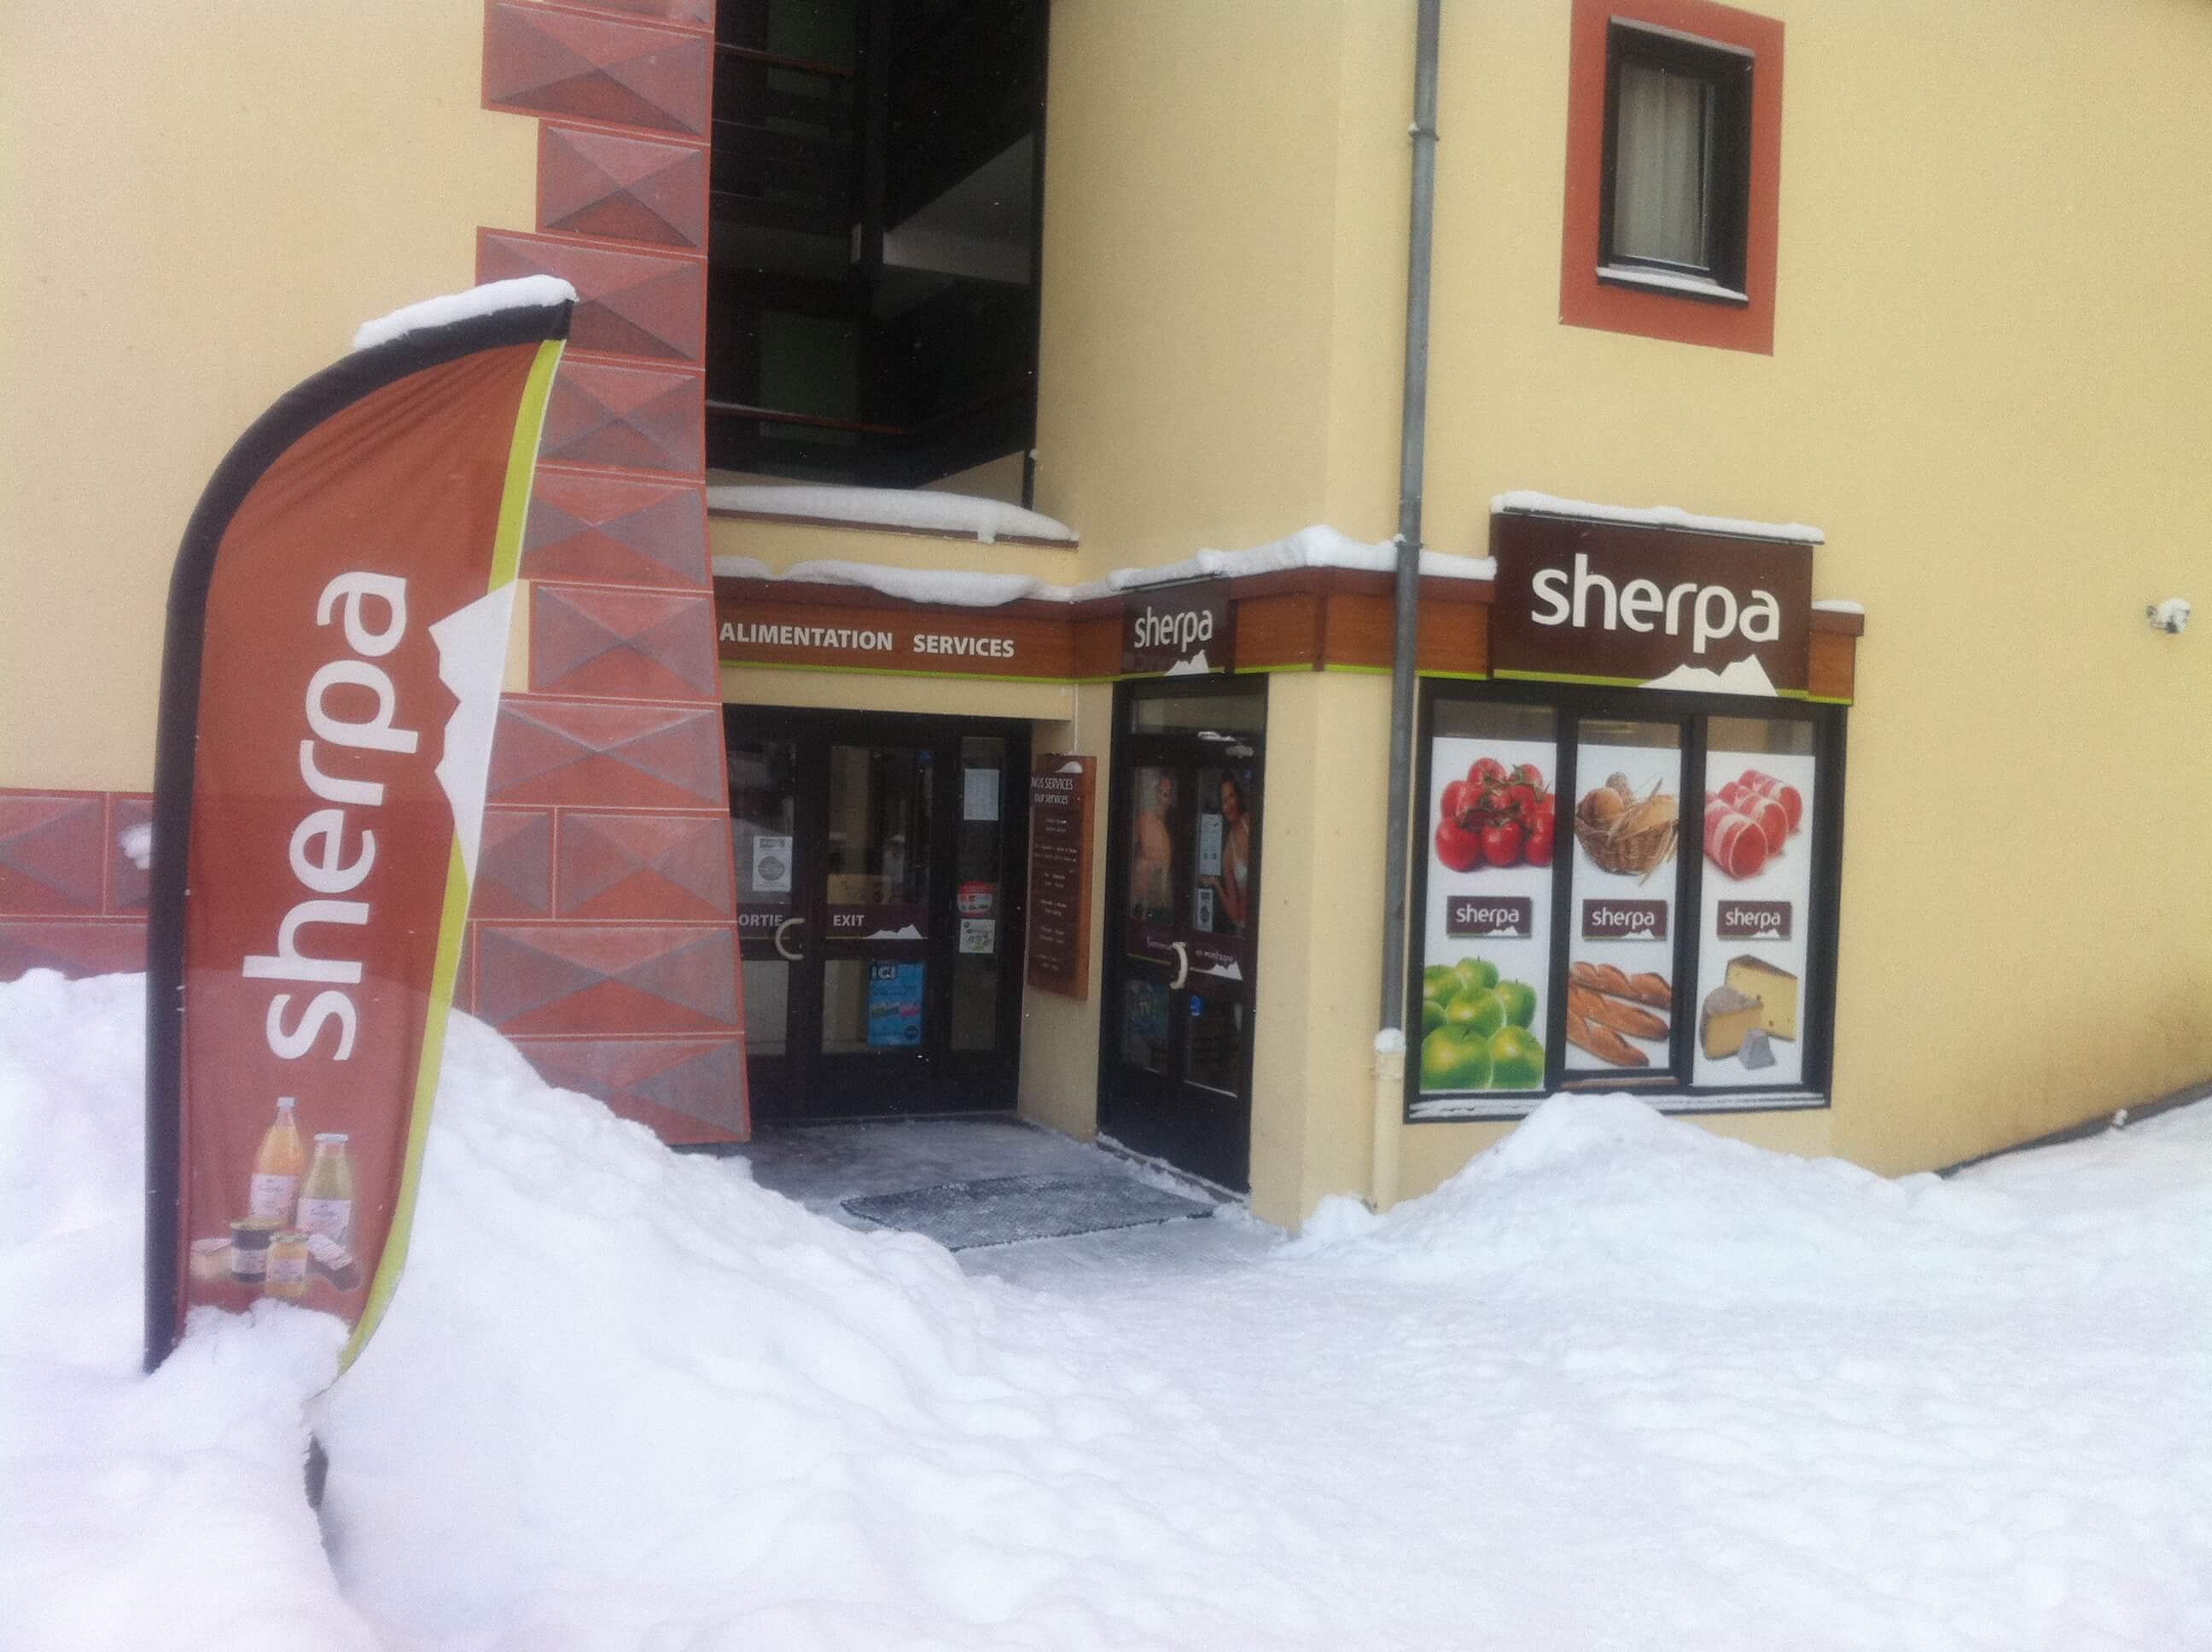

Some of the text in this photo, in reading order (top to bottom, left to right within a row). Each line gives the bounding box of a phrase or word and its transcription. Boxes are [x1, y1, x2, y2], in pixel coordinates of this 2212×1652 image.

[1532, 553, 1780, 654] sherpa
[719, 622, 1015, 658] ALIMENTATION SERVICES
[1134, 606, 1213, 653] sherpa
[1045, 777, 1074, 790] SERVICES
[242, 572, 419, 1062] sherpa
[737, 914, 783, 927] ORTIE
[833, 915, 865, 927] EXIT
[1456, 904, 1520, 928] sherpa
[1591, 906, 1656, 931] sherpa
[1725, 907, 1781, 932] sherpa
